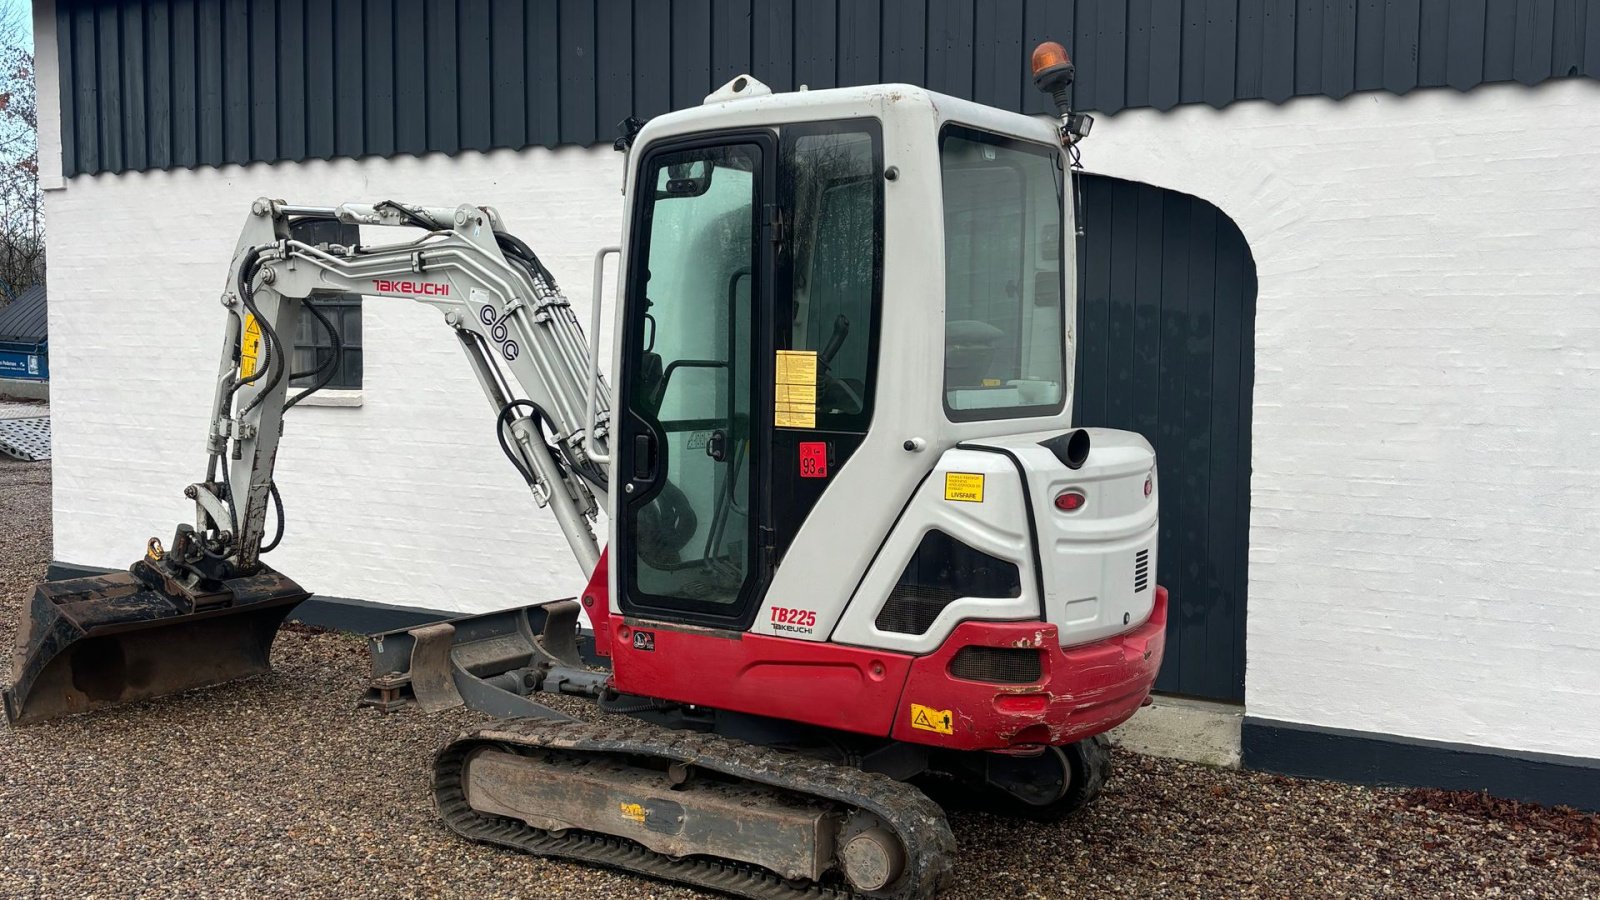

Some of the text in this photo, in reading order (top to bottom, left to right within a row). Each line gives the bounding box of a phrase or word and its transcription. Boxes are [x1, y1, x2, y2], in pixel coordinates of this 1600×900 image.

[372, 280, 449, 296] TAKEUCHI
[803, 457, 816, 474] 93
[770, 606, 817, 627] TB225
